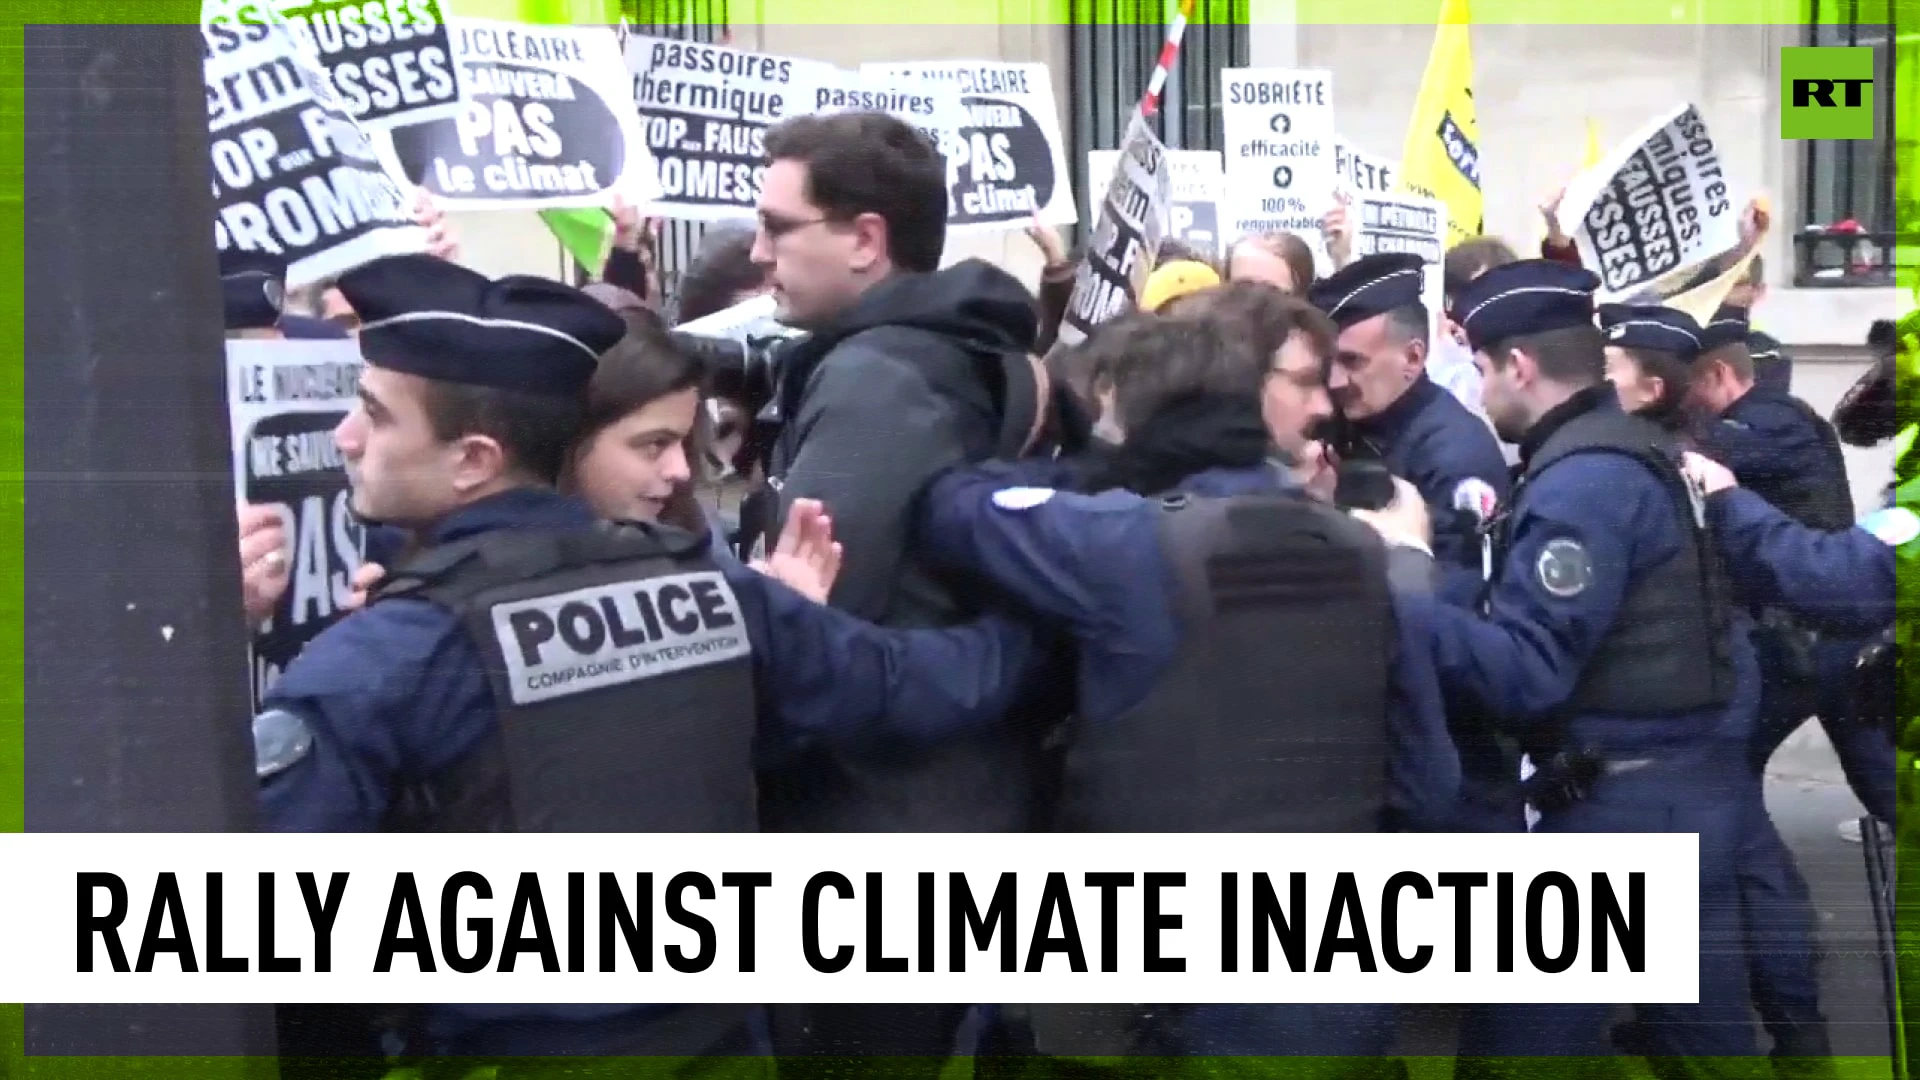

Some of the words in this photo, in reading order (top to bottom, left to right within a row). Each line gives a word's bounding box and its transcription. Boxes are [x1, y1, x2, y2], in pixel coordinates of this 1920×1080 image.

[651, 42, 792, 84] passoires
[815, 86, 934, 115] passoires
[1229, 80, 1325, 105] SOBRIÉTÉ
[456, 98, 562, 157] PAS
[1240, 139, 1321, 157] efficacité
[206, 128, 278, 198] OP
[433, 157, 475, 192] le
[484, 154, 600, 191] climat
[510, 580, 735, 667] POLICE
[527, 656, 624, 690] COMPAGNIE
[629, 636, 739, 671] D'INTERVENTION
